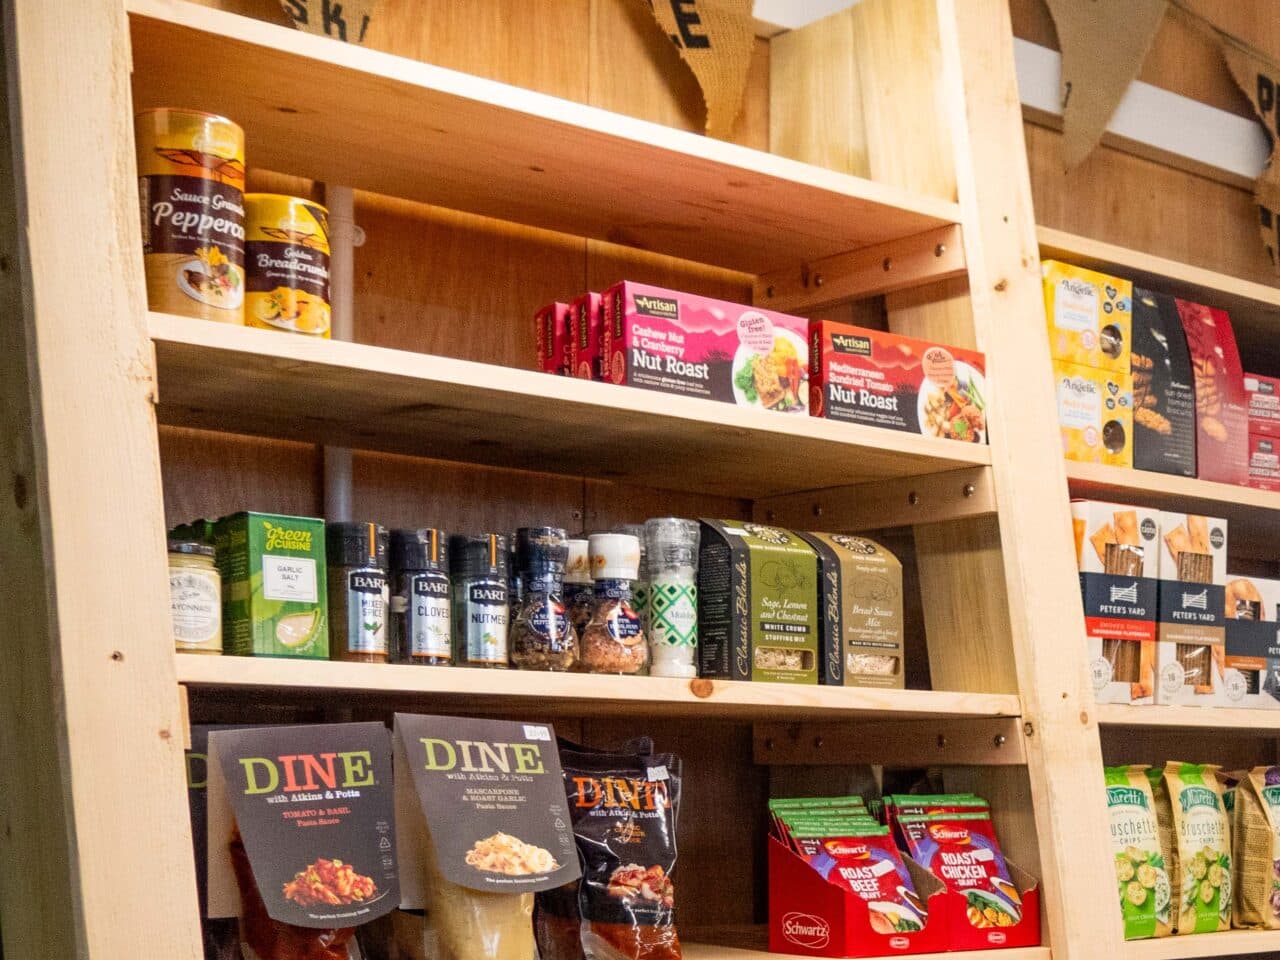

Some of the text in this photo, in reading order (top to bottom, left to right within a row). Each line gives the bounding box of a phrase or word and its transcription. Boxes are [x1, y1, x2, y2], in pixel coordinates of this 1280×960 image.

[170, 188, 210, 204] Sauce
[632, 324, 684, 343] Cashew Nut
[642, 338, 685, 356] Cranberry
[633, 348, 710, 380] Nut Roast
[829, 373, 894, 392] Sundried Tomato
[829, 385, 898, 411] Nut Roast
[266, 527, 312, 550] green
[275, 540, 311, 551] CUISINE
[277, 565, 303, 574] GARLIC
[1100, 605, 1145, 616] PETER'S YARD
[1200, 613, 1215, 622] YARD
[420, 738, 544, 774] DINE
[239, 751, 376, 795] DINE
[266, 789, 360, 804] with Atkins & Potts
[572, 776, 672, 811] DINE
[283, 809, 316, 819] TOMATO
[327, 807, 351, 816] BASIL
[932, 828, 969, 841] Schwartz
[828, 844, 868, 858] Schwartz
[941, 852, 978, 865] ROAST
[941, 864, 987, 879] CHICKEN
[850, 878, 879, 892] BEEF
[784, 920, 827, 938] Schwartz
